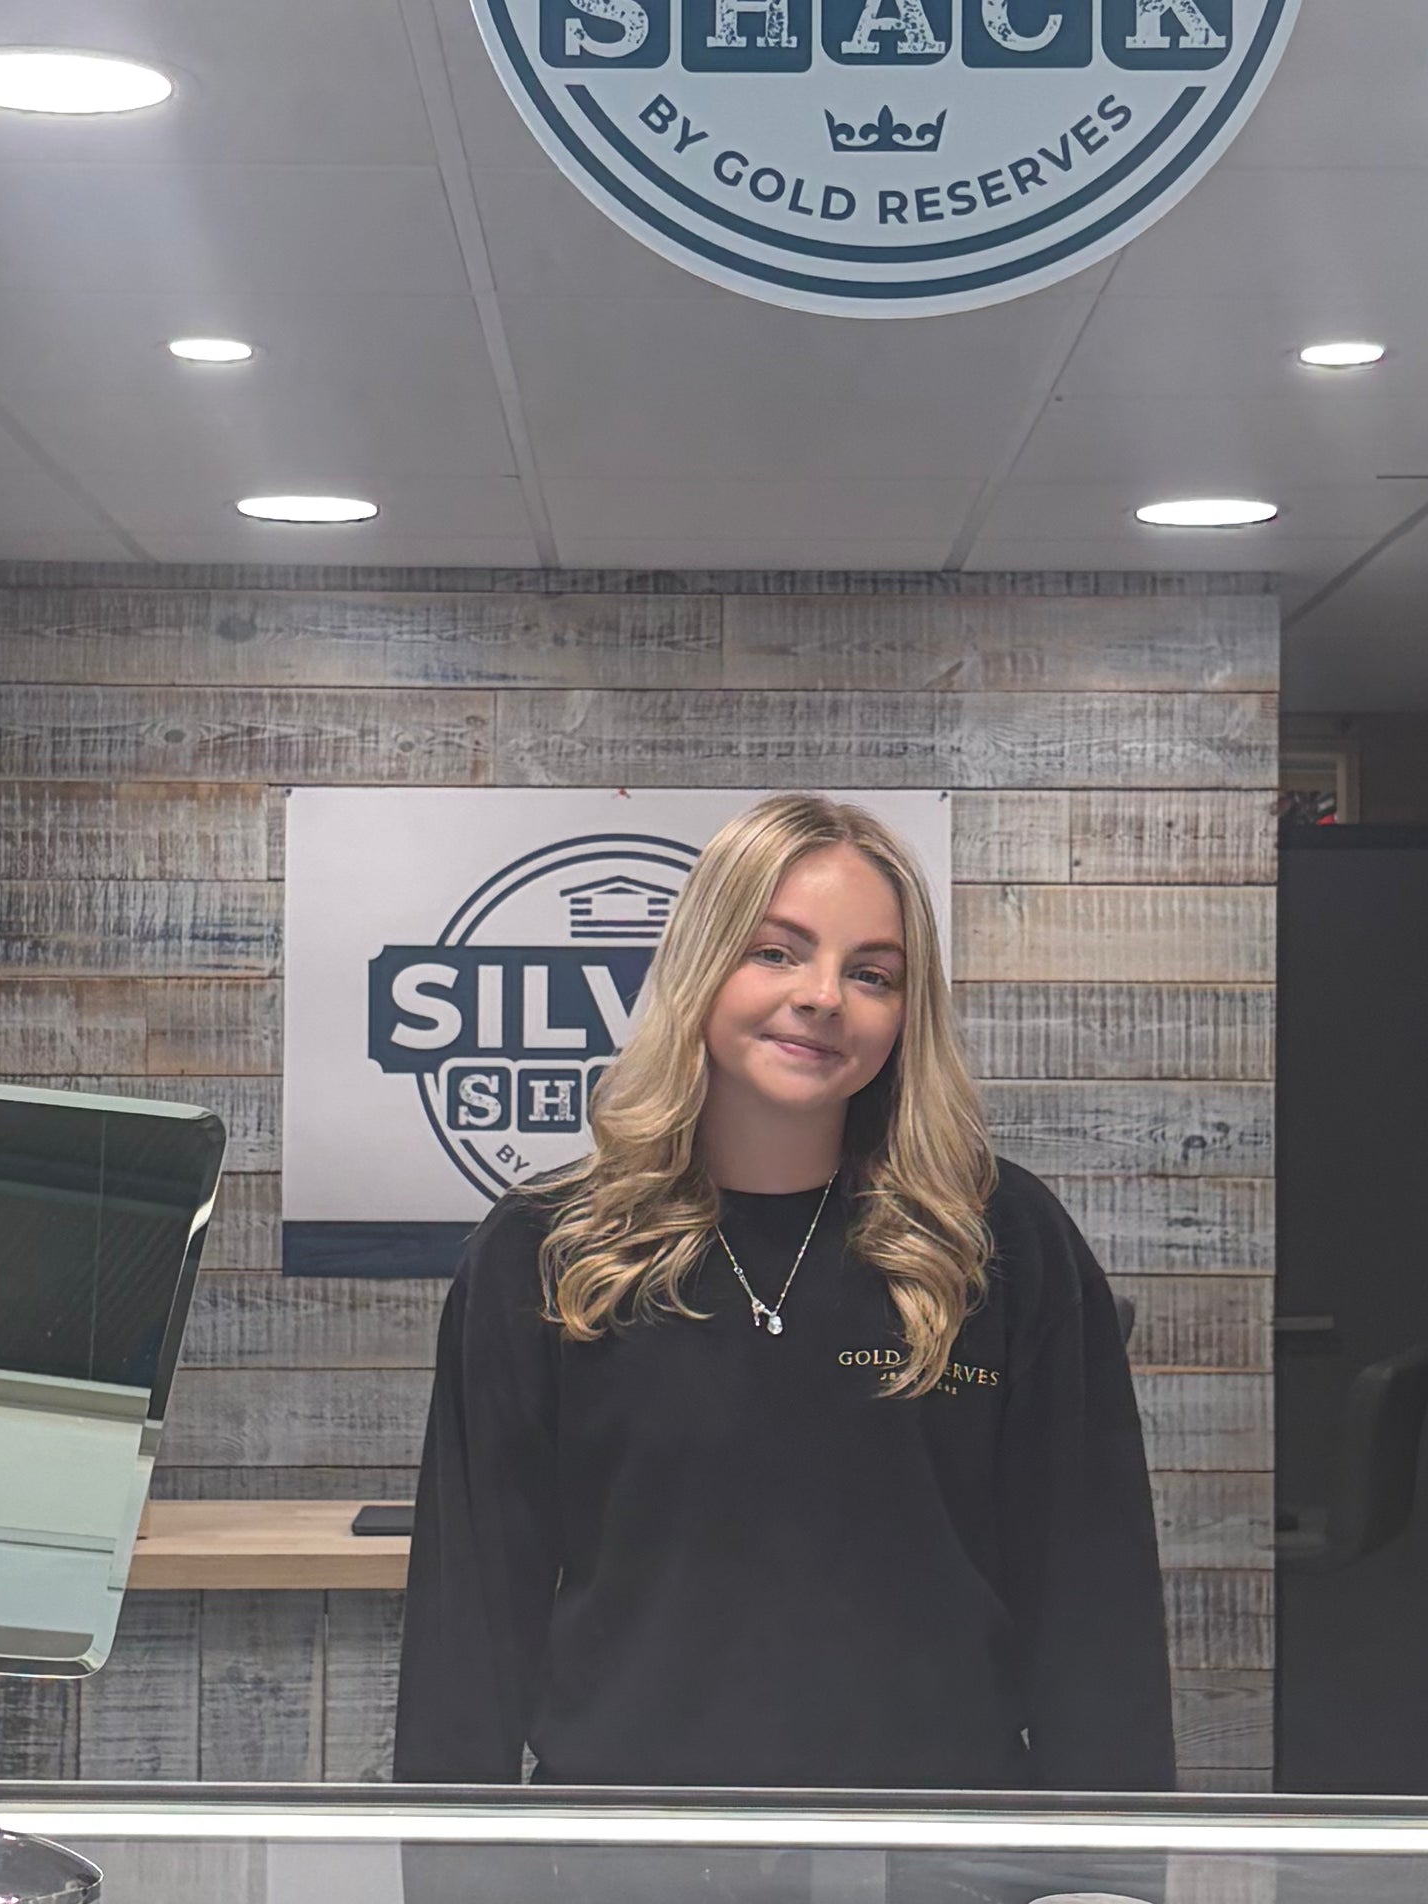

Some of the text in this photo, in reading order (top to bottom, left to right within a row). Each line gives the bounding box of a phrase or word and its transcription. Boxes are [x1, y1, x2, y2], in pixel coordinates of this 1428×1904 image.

[639, 93, 1133, 226] BY GOLD RESERVES
[390, 963, 651, 1050] SILV
[496, 1144, 530, 1173] BY
[838, 1349, 900, 1365] GOLD
